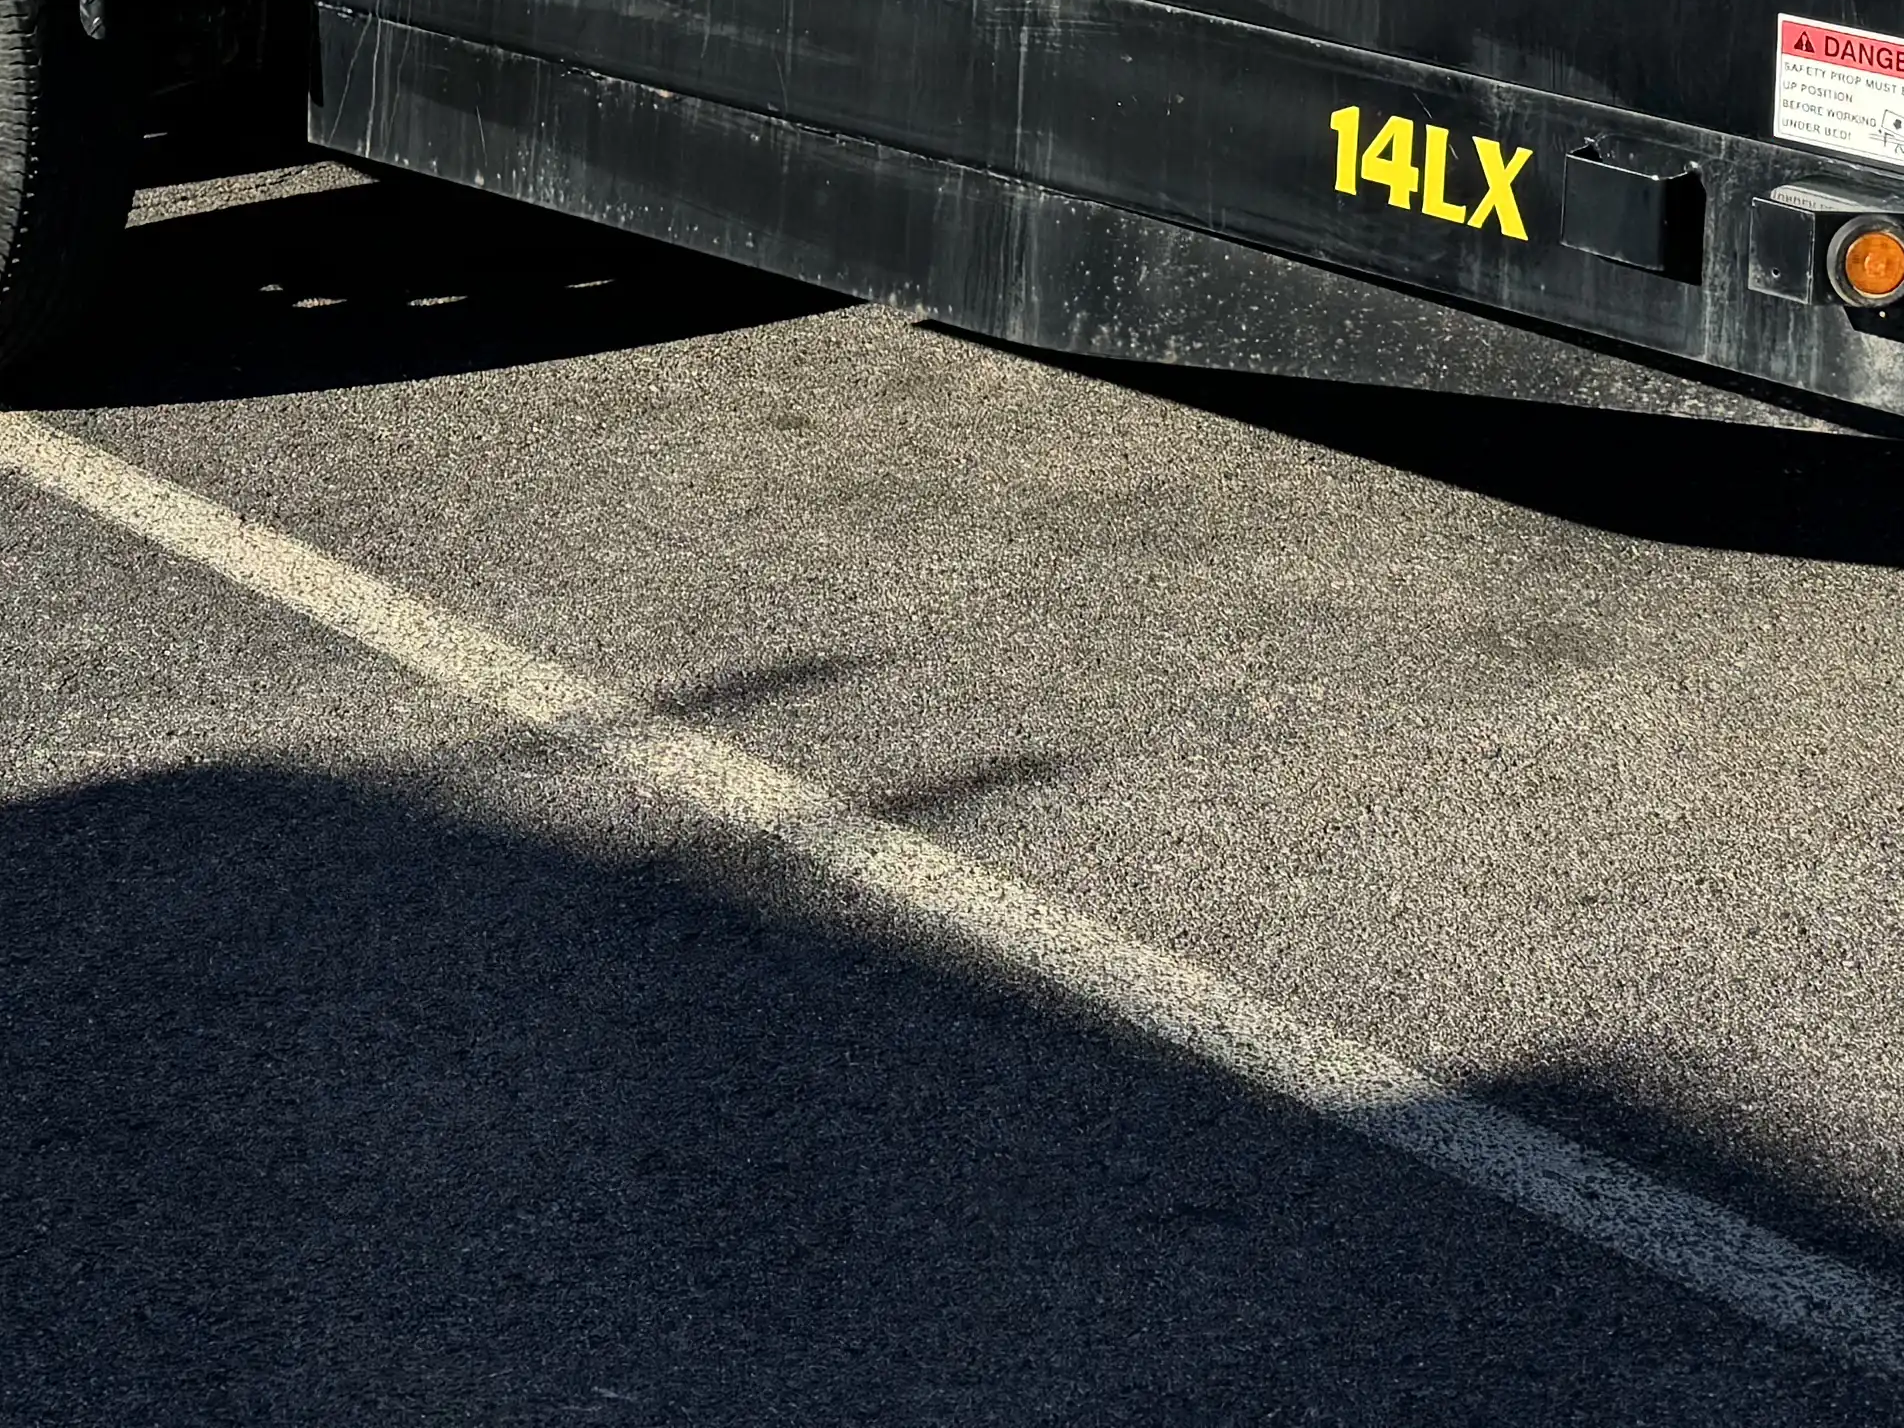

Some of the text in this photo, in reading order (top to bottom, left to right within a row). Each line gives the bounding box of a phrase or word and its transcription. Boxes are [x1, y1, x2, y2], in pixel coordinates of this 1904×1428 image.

[1783, 80, 1853, 103] UP POSITION
[1784, 61, 1826, 80] SAFETY
[1830, 71, 1862, 85] PROP
[1866, 79, 1896, 94] MUST
[1782, 99, 1877, 128] BEFORE WORKING
[1782, 118, 1820, 133] UNDER
[1330, 105, 1534, 241] 14LX
